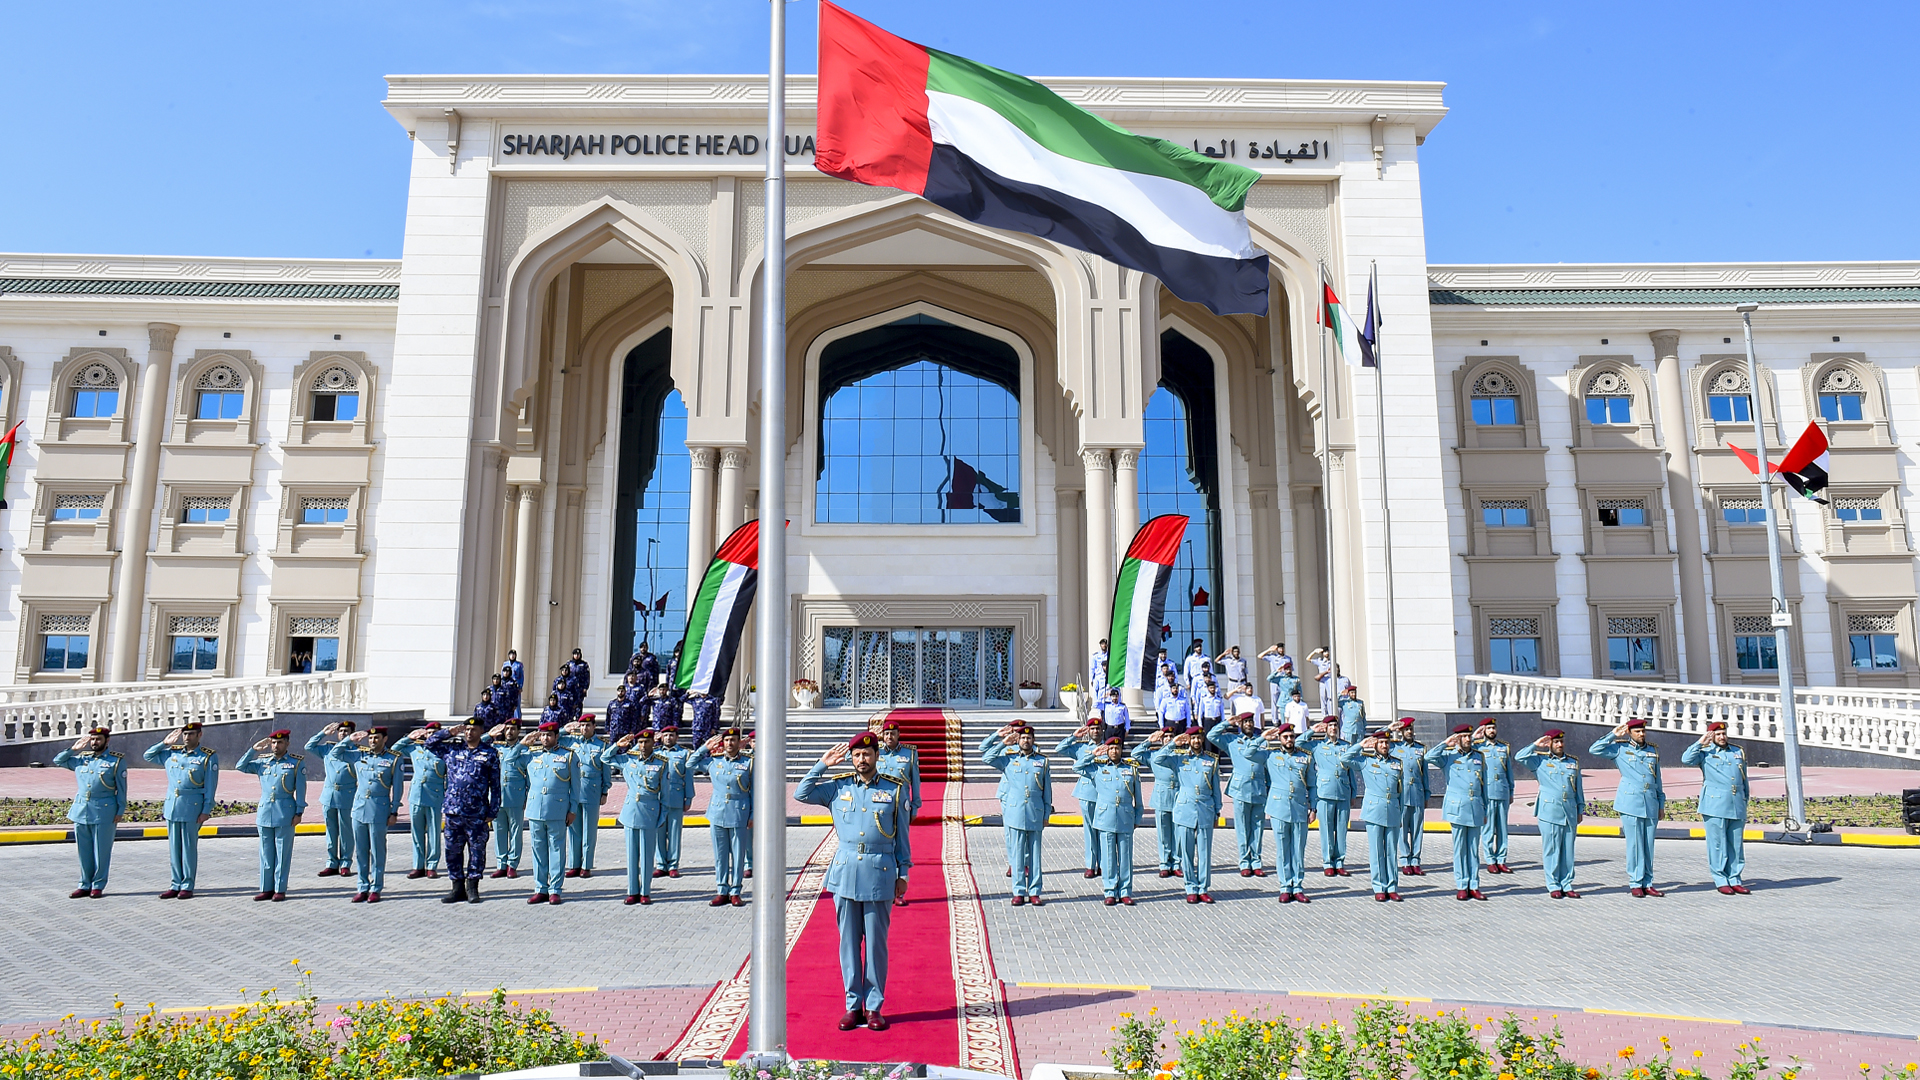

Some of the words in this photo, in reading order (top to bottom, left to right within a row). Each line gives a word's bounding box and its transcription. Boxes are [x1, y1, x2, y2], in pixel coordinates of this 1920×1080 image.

[502, 134, 605, 161] SHARJAH
[610, 134, 690, 156] POLICE
[695, 134, 760, 156] HEAD
[765, 134, 816, 156] UA
[1248, 138, 1329, 164] القيادة
